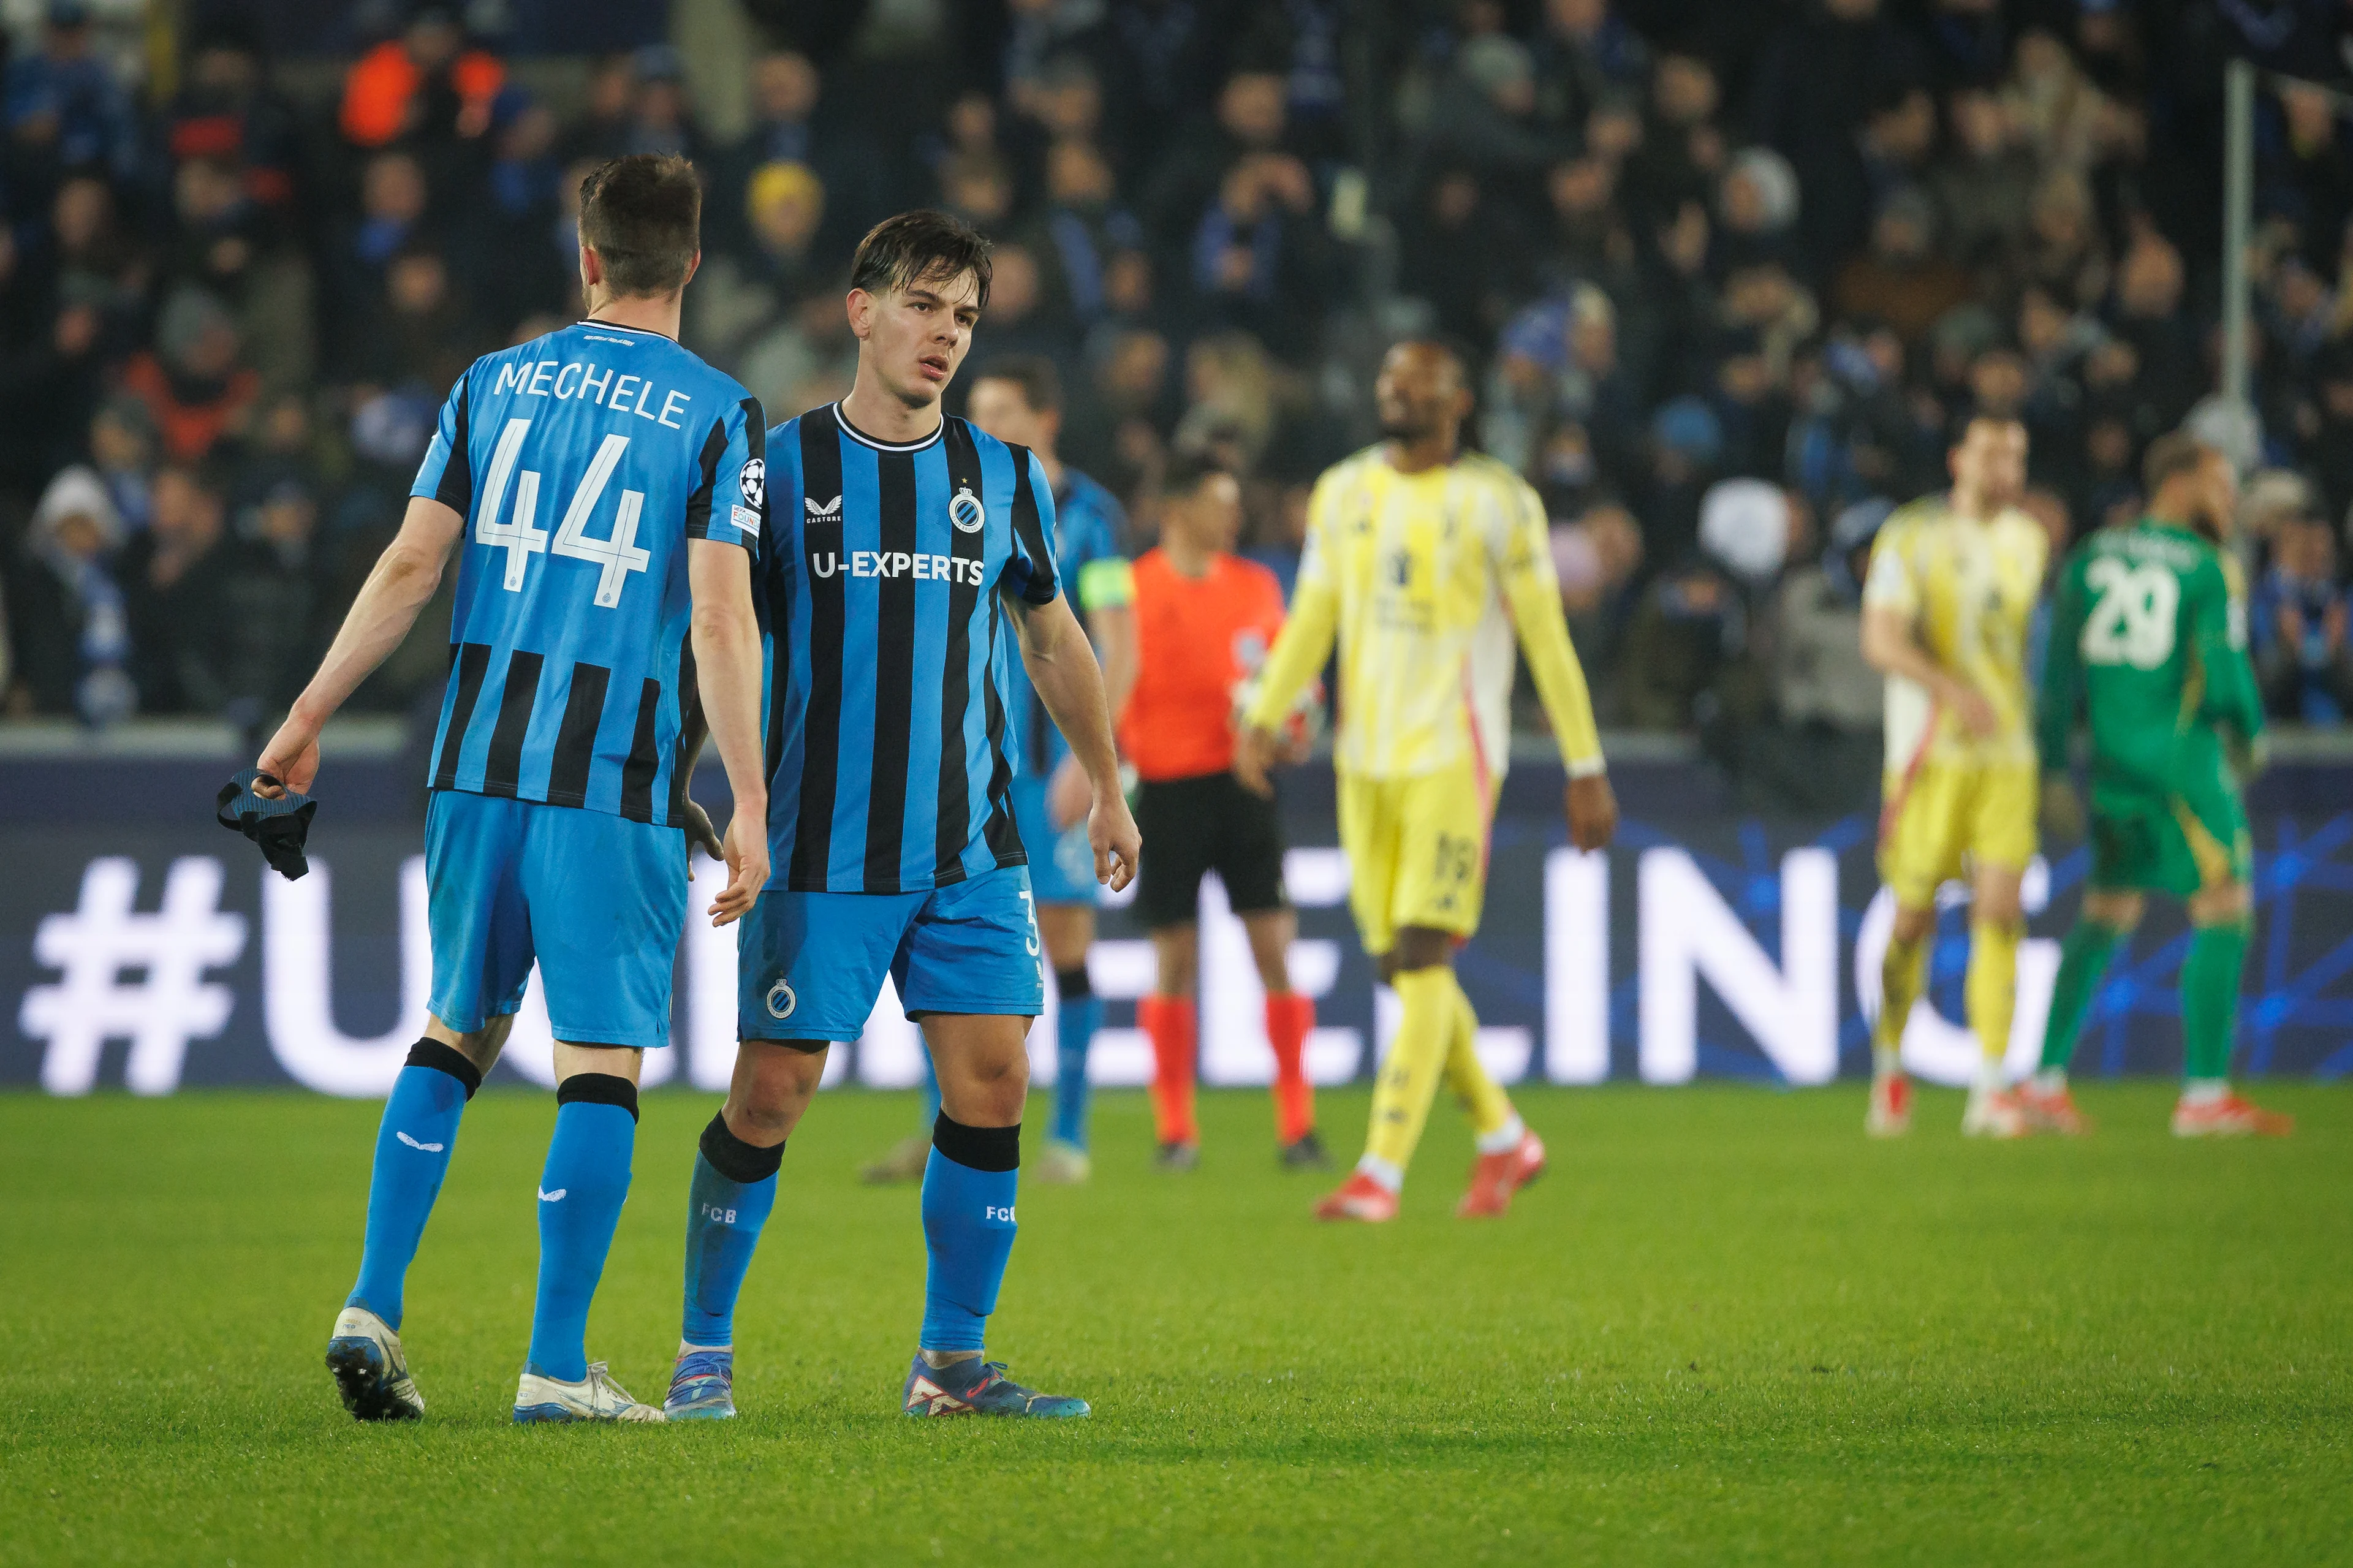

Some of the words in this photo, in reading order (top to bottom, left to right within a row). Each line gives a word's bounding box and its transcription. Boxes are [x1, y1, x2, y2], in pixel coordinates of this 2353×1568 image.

[494, 361, 691, 430] MECHELE
[475, 418, 651, 609] 44
[813, 551, 985, 586] U-EXPERTS
[2078, 556, 2180, 670] 29
[702, 1202, 737, 1224] FCB
